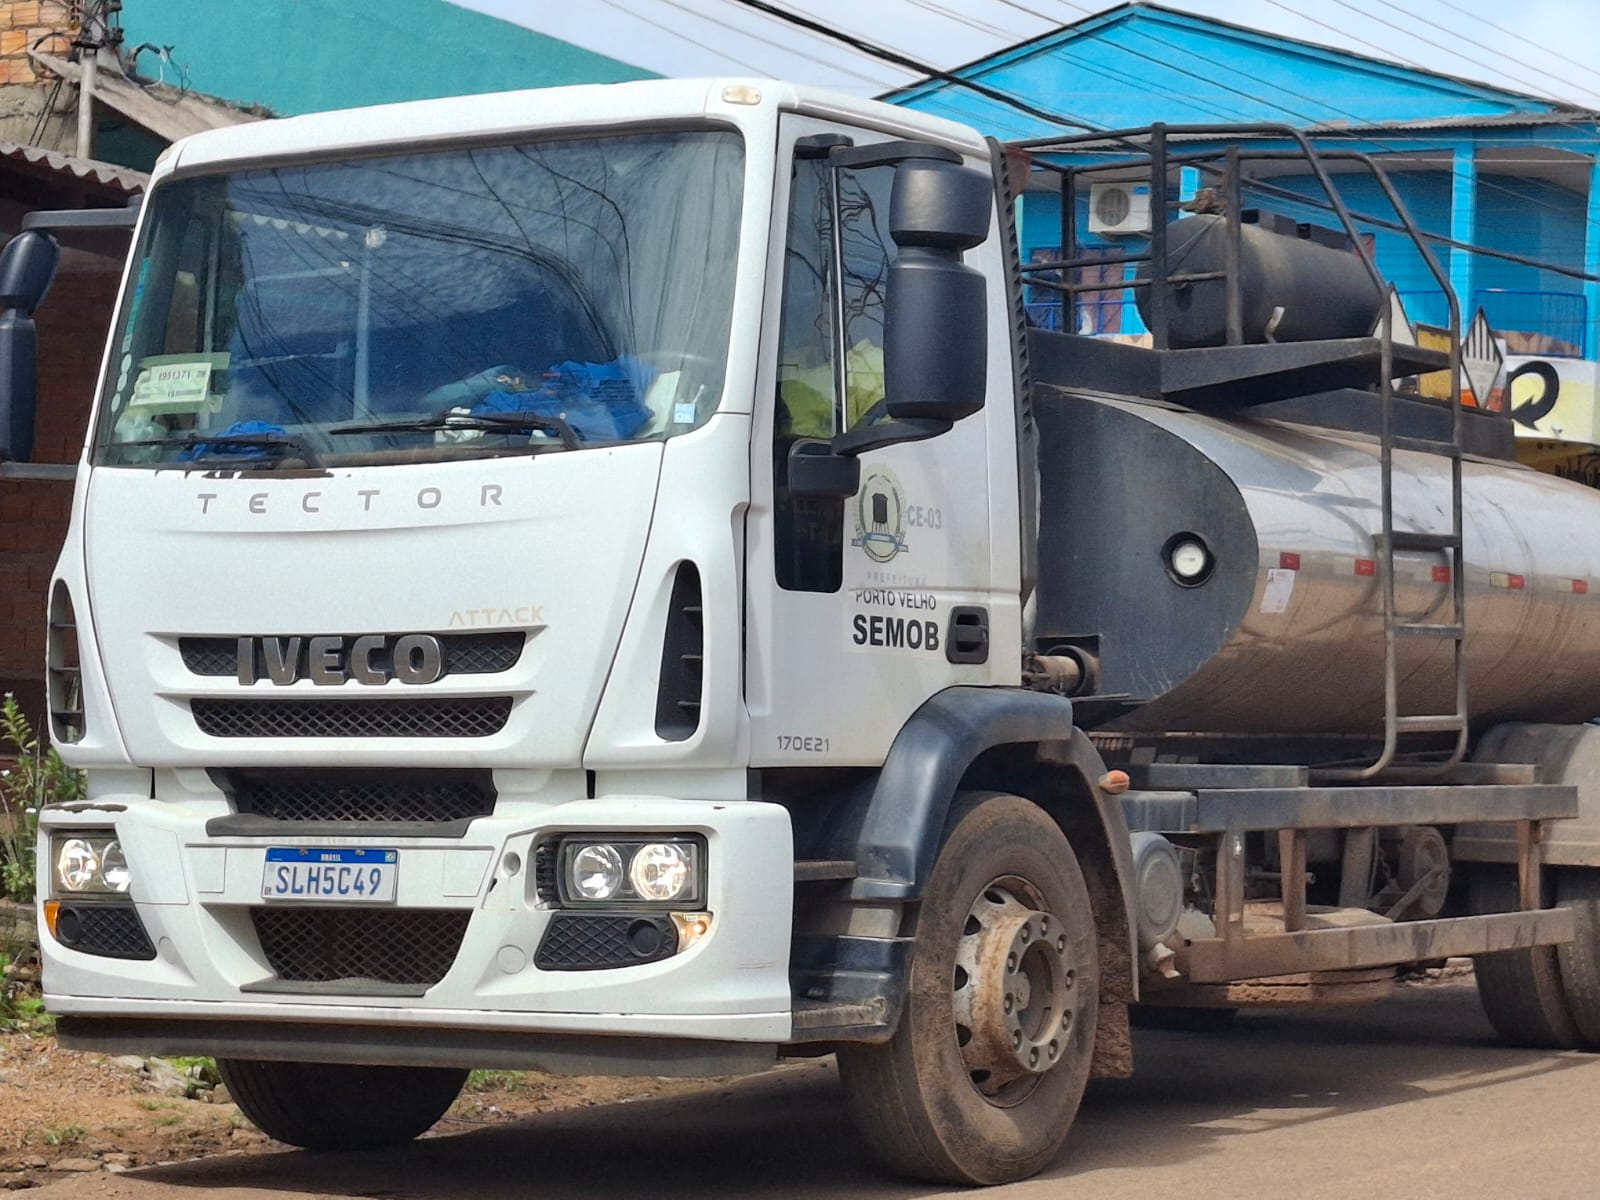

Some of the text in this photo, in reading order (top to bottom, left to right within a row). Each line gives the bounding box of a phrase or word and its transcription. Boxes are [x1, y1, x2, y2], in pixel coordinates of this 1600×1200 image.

[197, 484, 503, 514] TECTOR
[907, 505, 942, 530] CE-03
[855, 589, 937, 610] PORTO VELHO
[449, 606, 545, 627] ATTACK
[852, 614, 940, 651] SEMOB
[237, 634, 442, 686] IVECO
[777, 735, 829, 753] 170E21
[276, 866, 382, 895] SLH5C49
